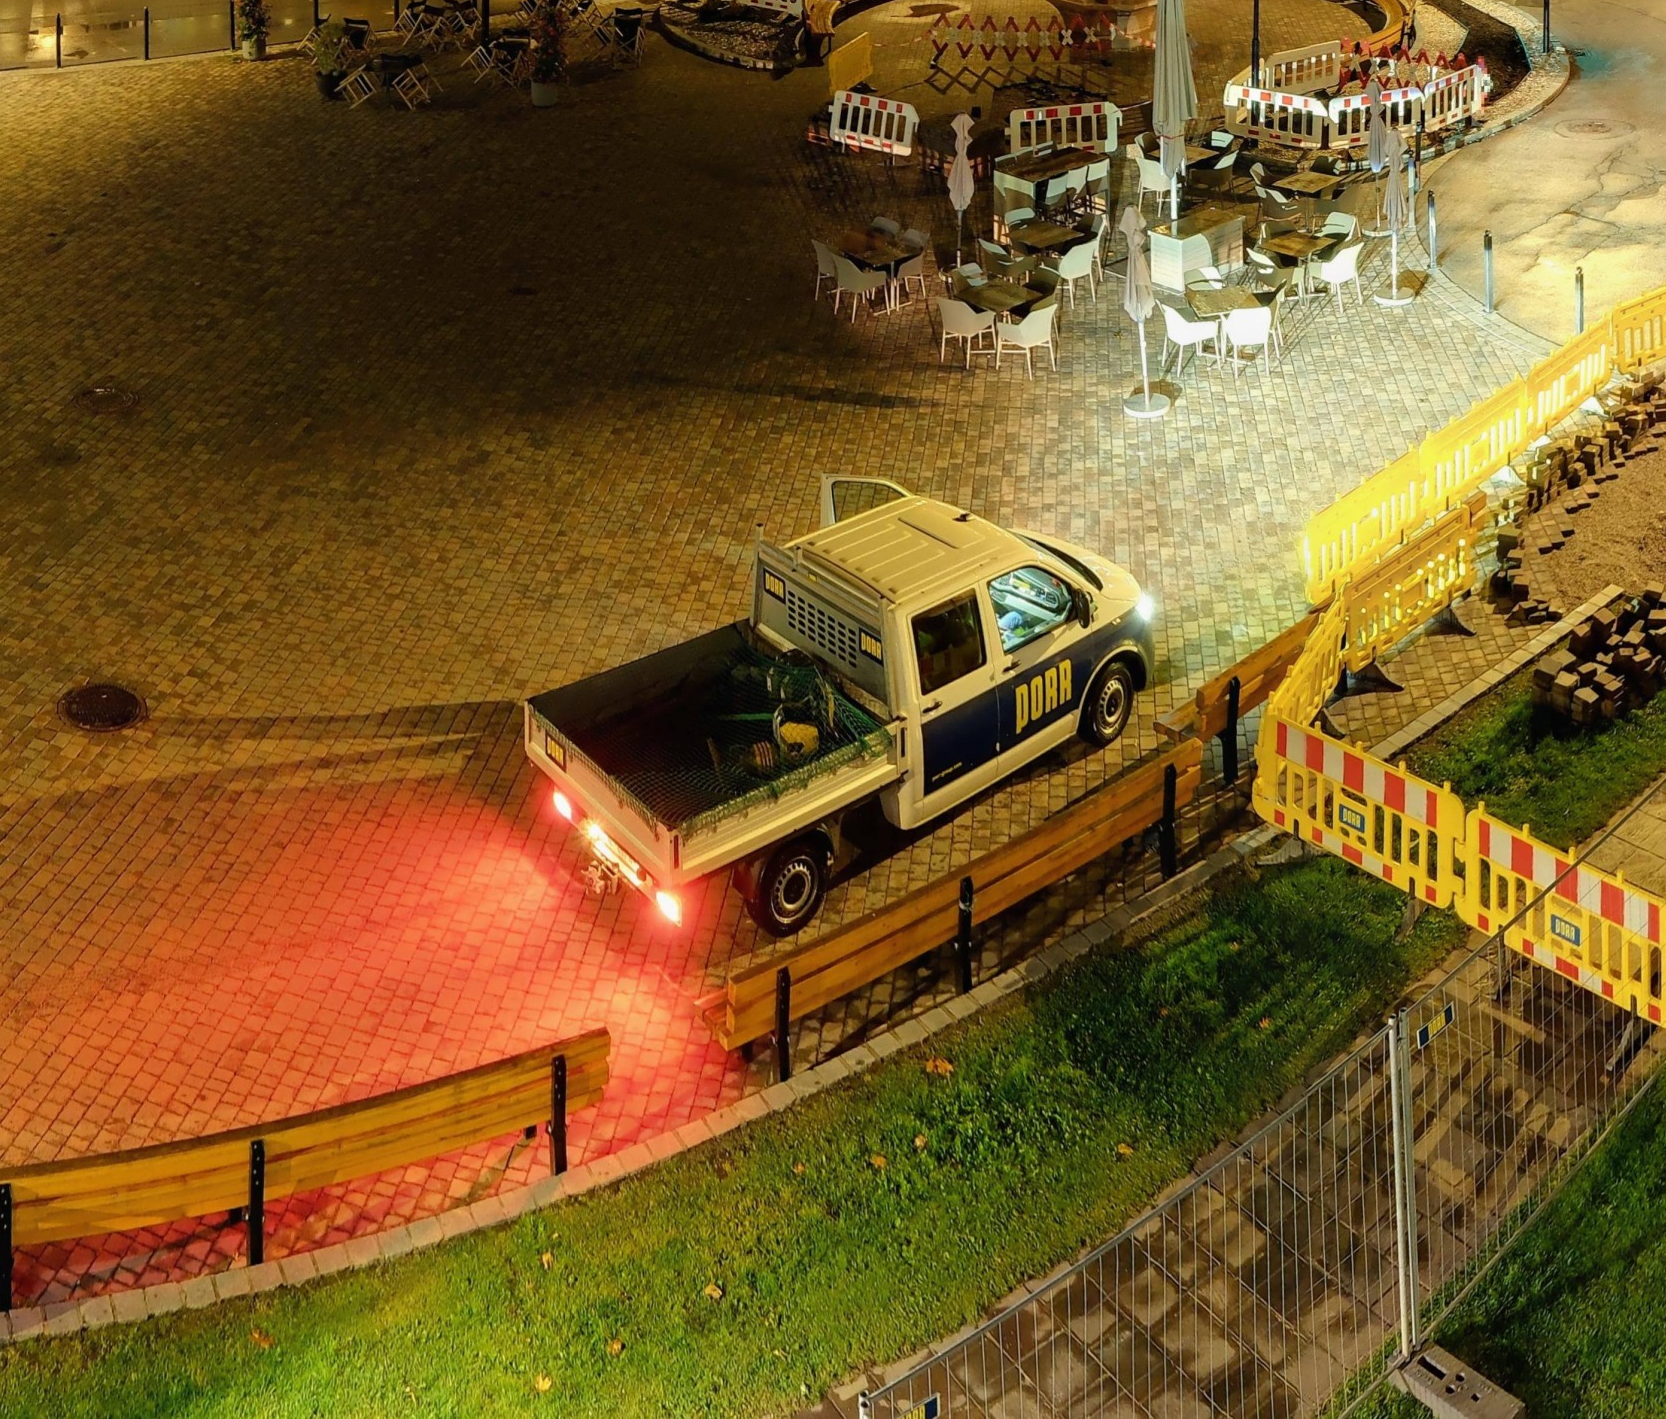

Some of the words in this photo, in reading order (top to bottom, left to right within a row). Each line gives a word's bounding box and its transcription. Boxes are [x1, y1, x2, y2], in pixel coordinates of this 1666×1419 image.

[1015, 658, 1072, 735] PORR
[1342, 806, 1362, 829] PORR
[1554, 916, 1576, 941] PORR
